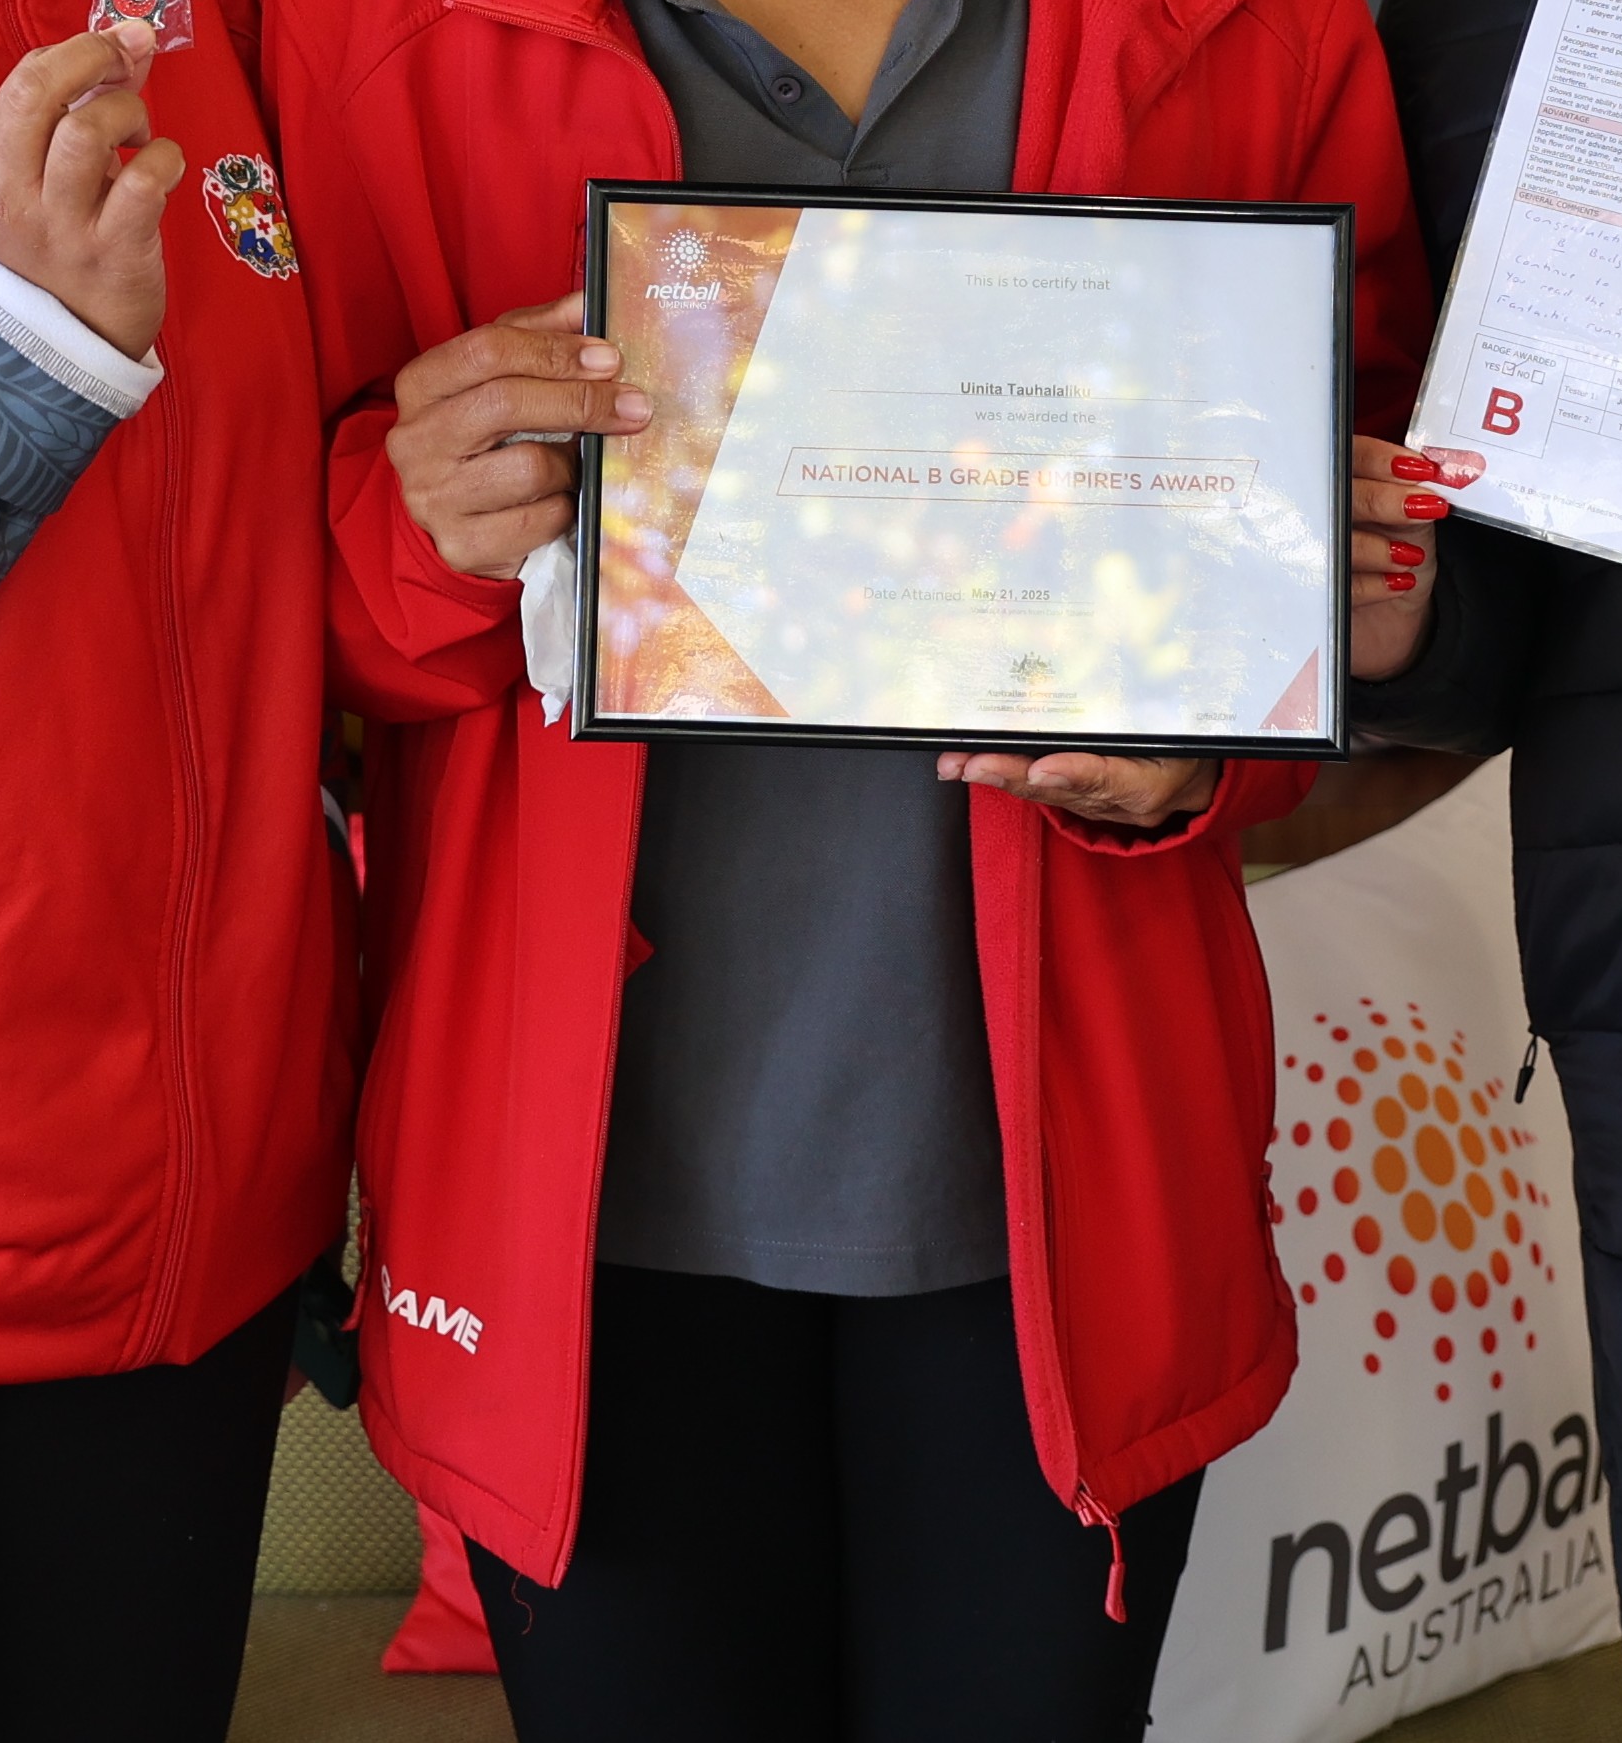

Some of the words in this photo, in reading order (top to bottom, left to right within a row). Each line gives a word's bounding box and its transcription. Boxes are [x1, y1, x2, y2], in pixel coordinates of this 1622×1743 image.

[1584, 25, 1610, 37] player
[1608, 31, 1622, 41] not
[1541, 105, 1590, 125] ADVANTAGE
[1517, 190, 1554, 207] GENERAL
[1555, 199, 1600, 218] COMMENTS
[645, 280, 721, 301] netball
[965, 273, 994, 288] This
[999, 274, 1010, 288] is
[1014, 276, 1027, 289] to
[1031, 275, 1078, 294] certify
[1082, 276, 1111, 291] that
[658, 300, 707, 310] UMPIRING
[1480, 340, 1512, 356] BADGE
[1511, 349, 1557, 368] AWARDED
[1483, 360, 1501, 372] YES
[1515, 368, 1531, 380] NO
[960, 381, 1003, 397] Uinita
[975, 411, 1003, 423] was
[1007, 409, 1068, 424] awarded
[1072, 410, 1096, 425] the
[1481, 386, 1524, 436] B
[1557, 407, 1583, 421] Tester
[801, 463, 920, 485] NATIONAL
[928, 465, 942, 484] B
[950, 467, 1030, 487] GRADE
[1037, 469, 1143, 490] UMPIRE'S
[1149, 474, 1236, 493] AWARD
[863, 586, 897, 601] Date
[901, 587, 966, 602] Attained:
[971, 588, 997, 603] May
[1000, 588, 1018, 603] 21,
[1021, 588, 1050, 602] 2025
[1339, 1527, 1606, 1706] AUSTRALIA
